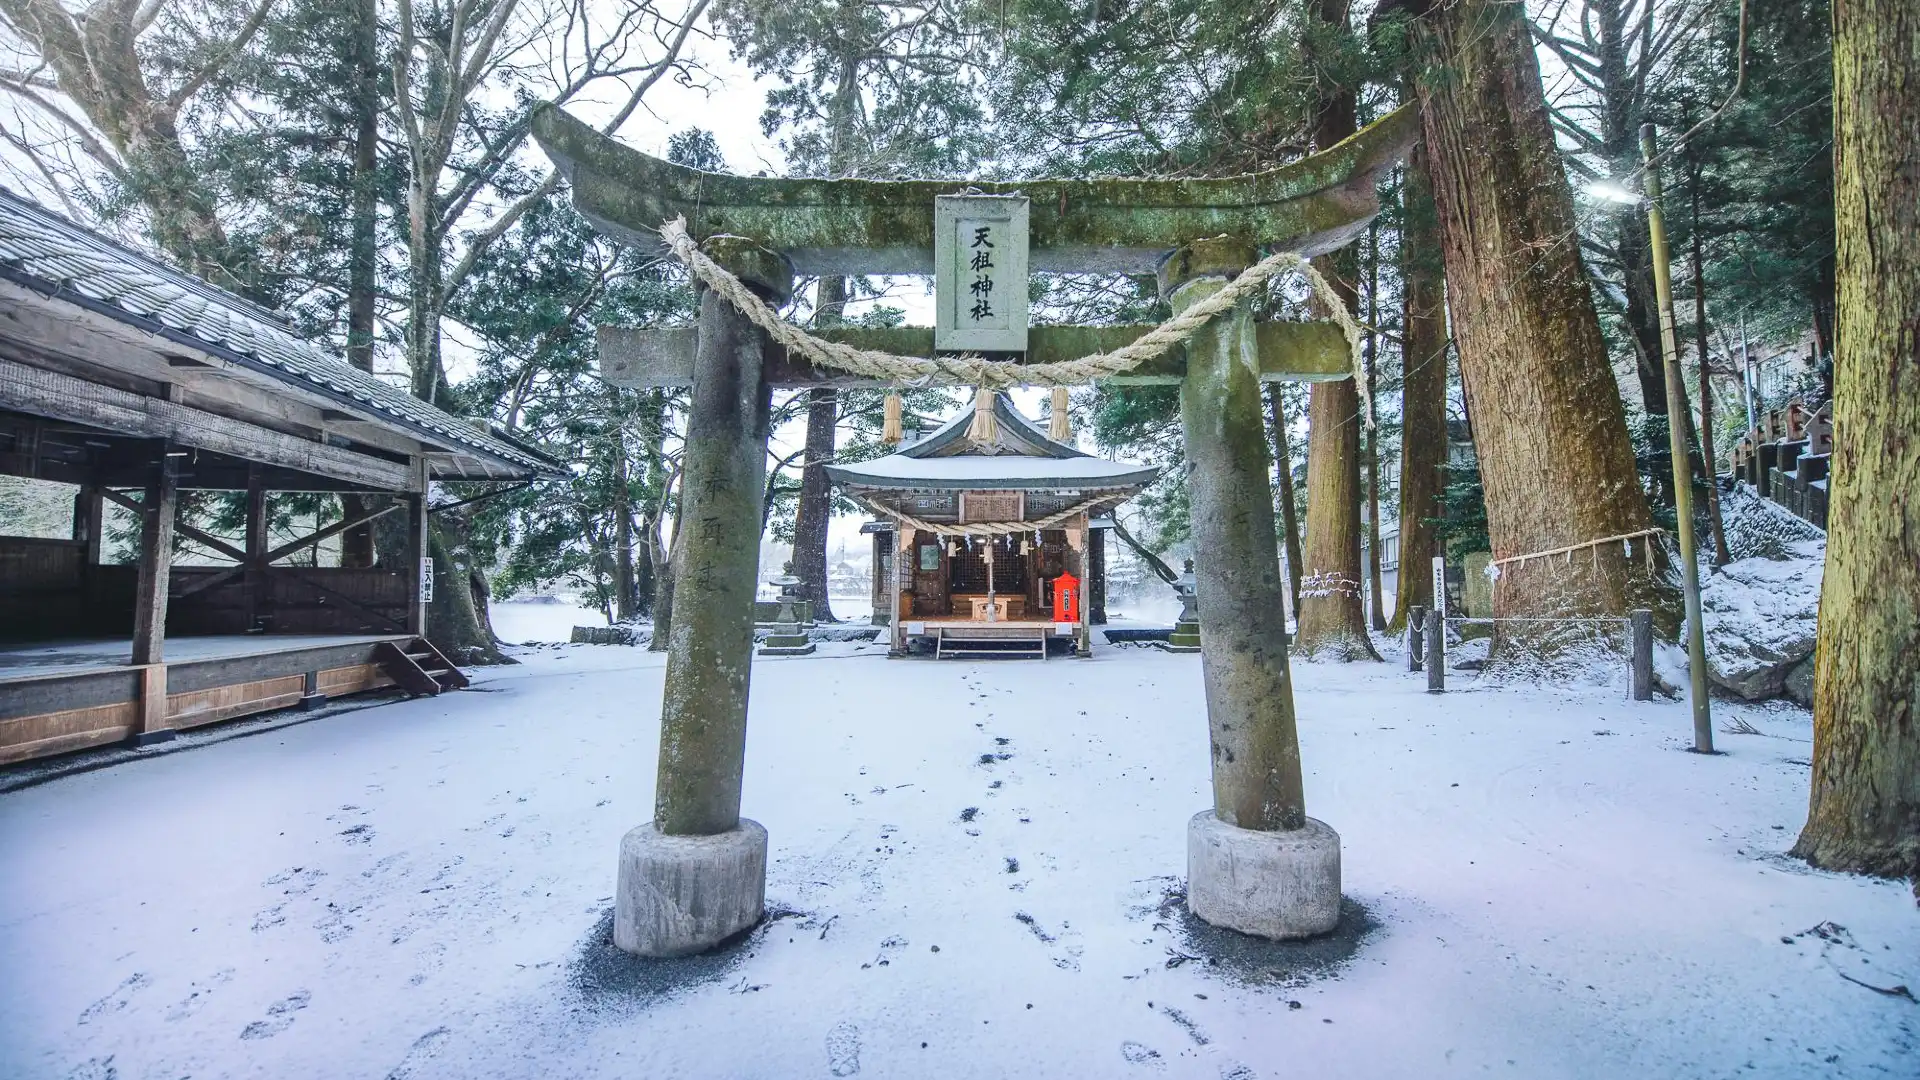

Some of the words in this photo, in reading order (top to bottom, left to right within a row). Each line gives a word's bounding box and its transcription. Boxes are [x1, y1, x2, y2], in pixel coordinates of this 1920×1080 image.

[970, 226, 995, 322] 天祖神社
[424, 565, 432, 601] 立入禁止
